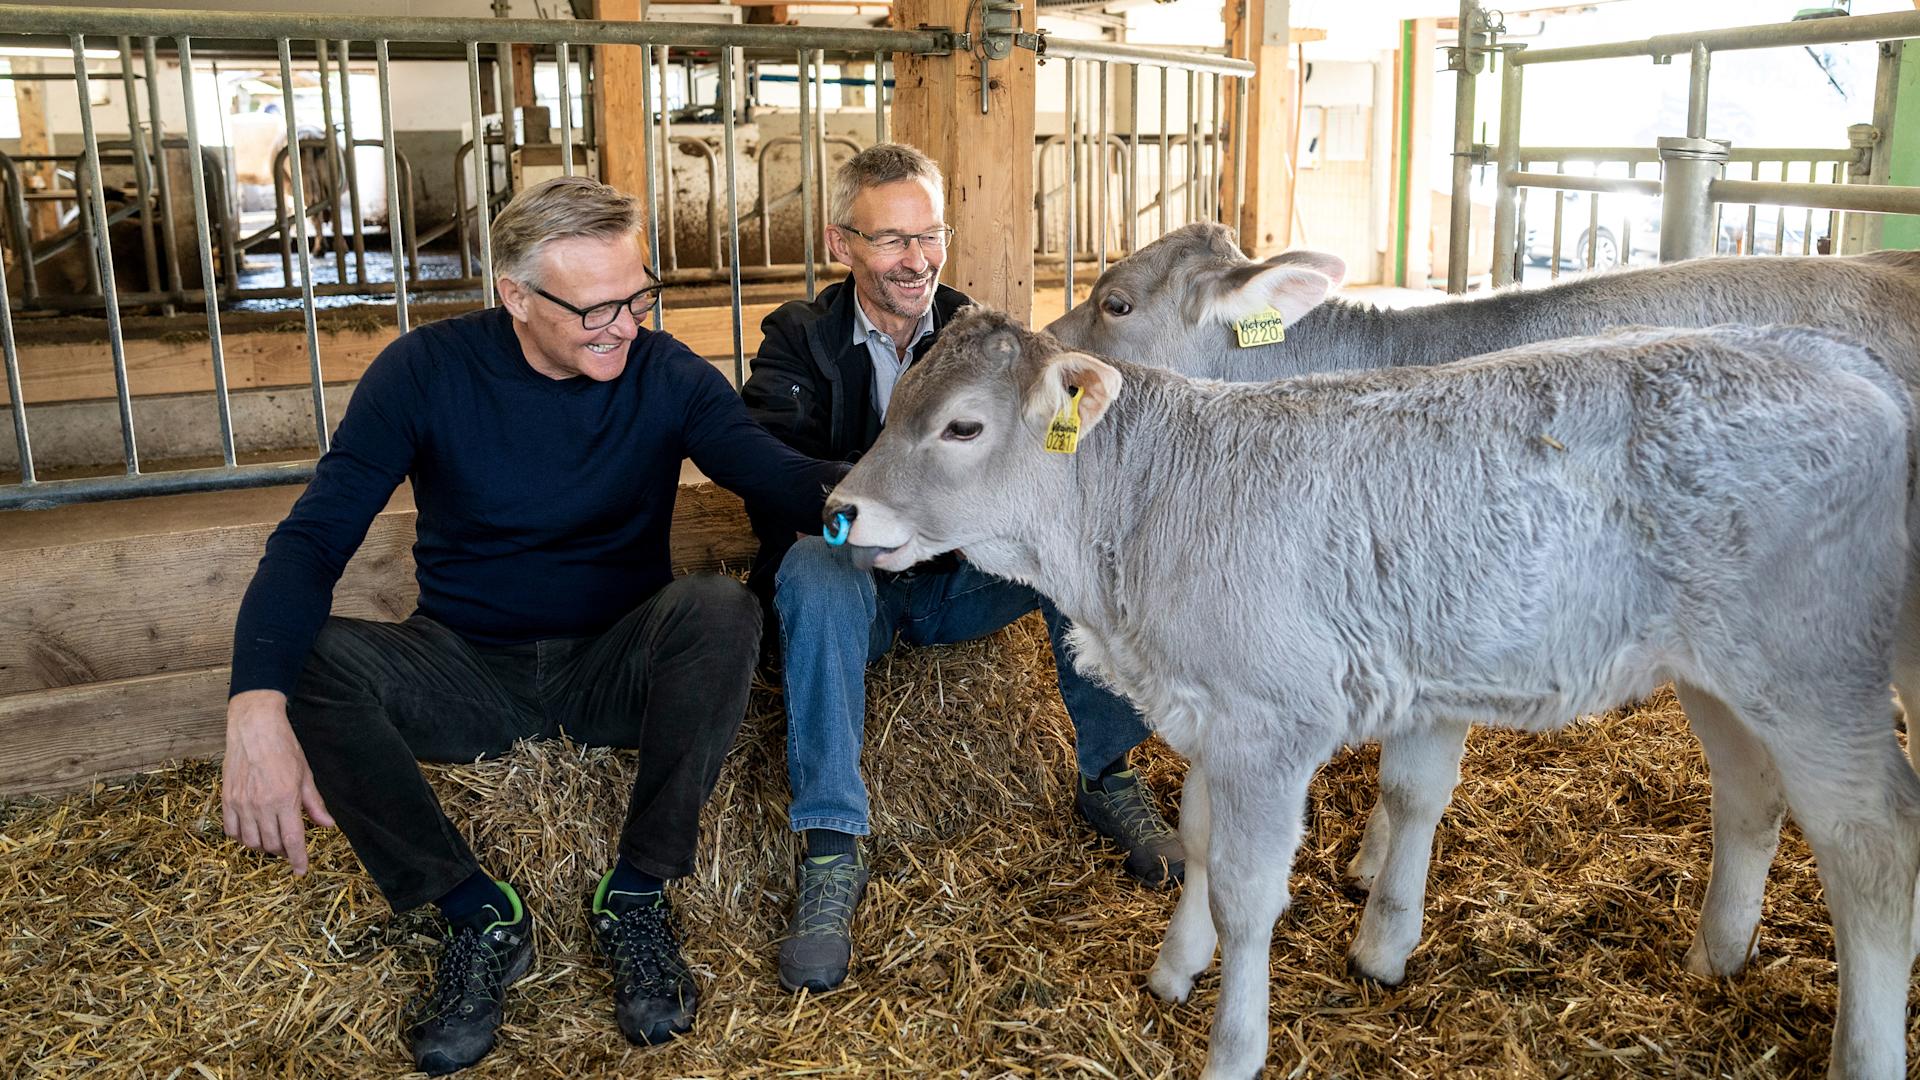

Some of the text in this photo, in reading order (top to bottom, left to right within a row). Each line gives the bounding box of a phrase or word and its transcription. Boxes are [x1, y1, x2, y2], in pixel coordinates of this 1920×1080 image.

[1239, 316, 1283, 331] Victoria
[1242, 326, 1278, 344] 0220
[1046, 432, 1070, 451] 0221
